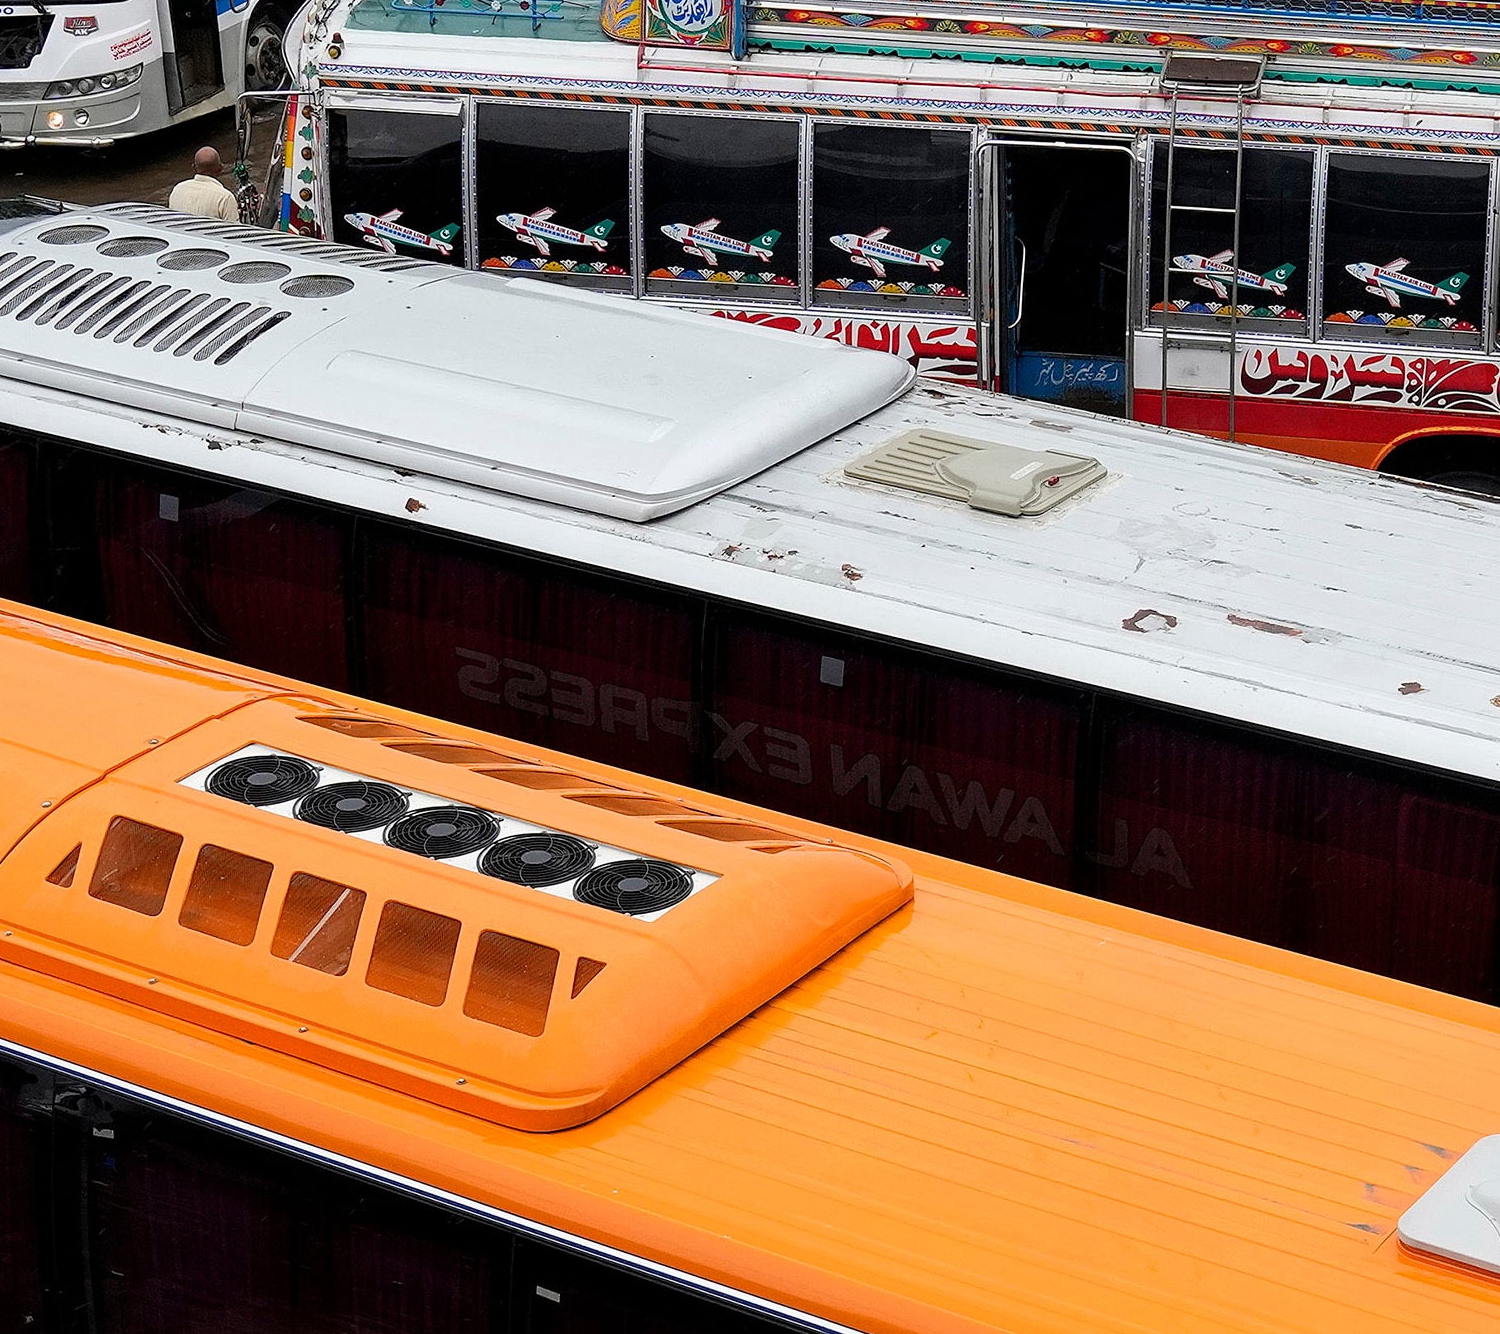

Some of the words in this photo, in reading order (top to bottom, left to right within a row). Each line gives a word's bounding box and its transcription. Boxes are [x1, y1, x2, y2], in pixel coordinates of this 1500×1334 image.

[68, 18, 92, 28] Hino
[75, 28, 88, 36] AK
[375, 217, 402, 234] PAKISTAN
[402, 227, 414, 237] AIR
[414, 230, 427, 241] LINE
[527, 217, 554, 232] PAKISTAN
[555, 225, 567, 235] AIR
[567, 228, 581, 238] LINE
[693, 228, 720, 243] PAKISTAN
[721, 236, 732, 246] AIR
[733, 239, 746, 249] LINE
[863, 237, 890, 253] PAKISTAN
[891, 245, 902, 255] AIR
[902, 248, 916, 258] LINE
[1206, 259, 1234, 275] PAKISTAN
[1235, 267, 1246, 278] AIR
[1379, 266, 1408, 283] PAKISTAN
[1408, 276, 1419, 287] AIR
[1419, 280, 1433, 292] LINE
